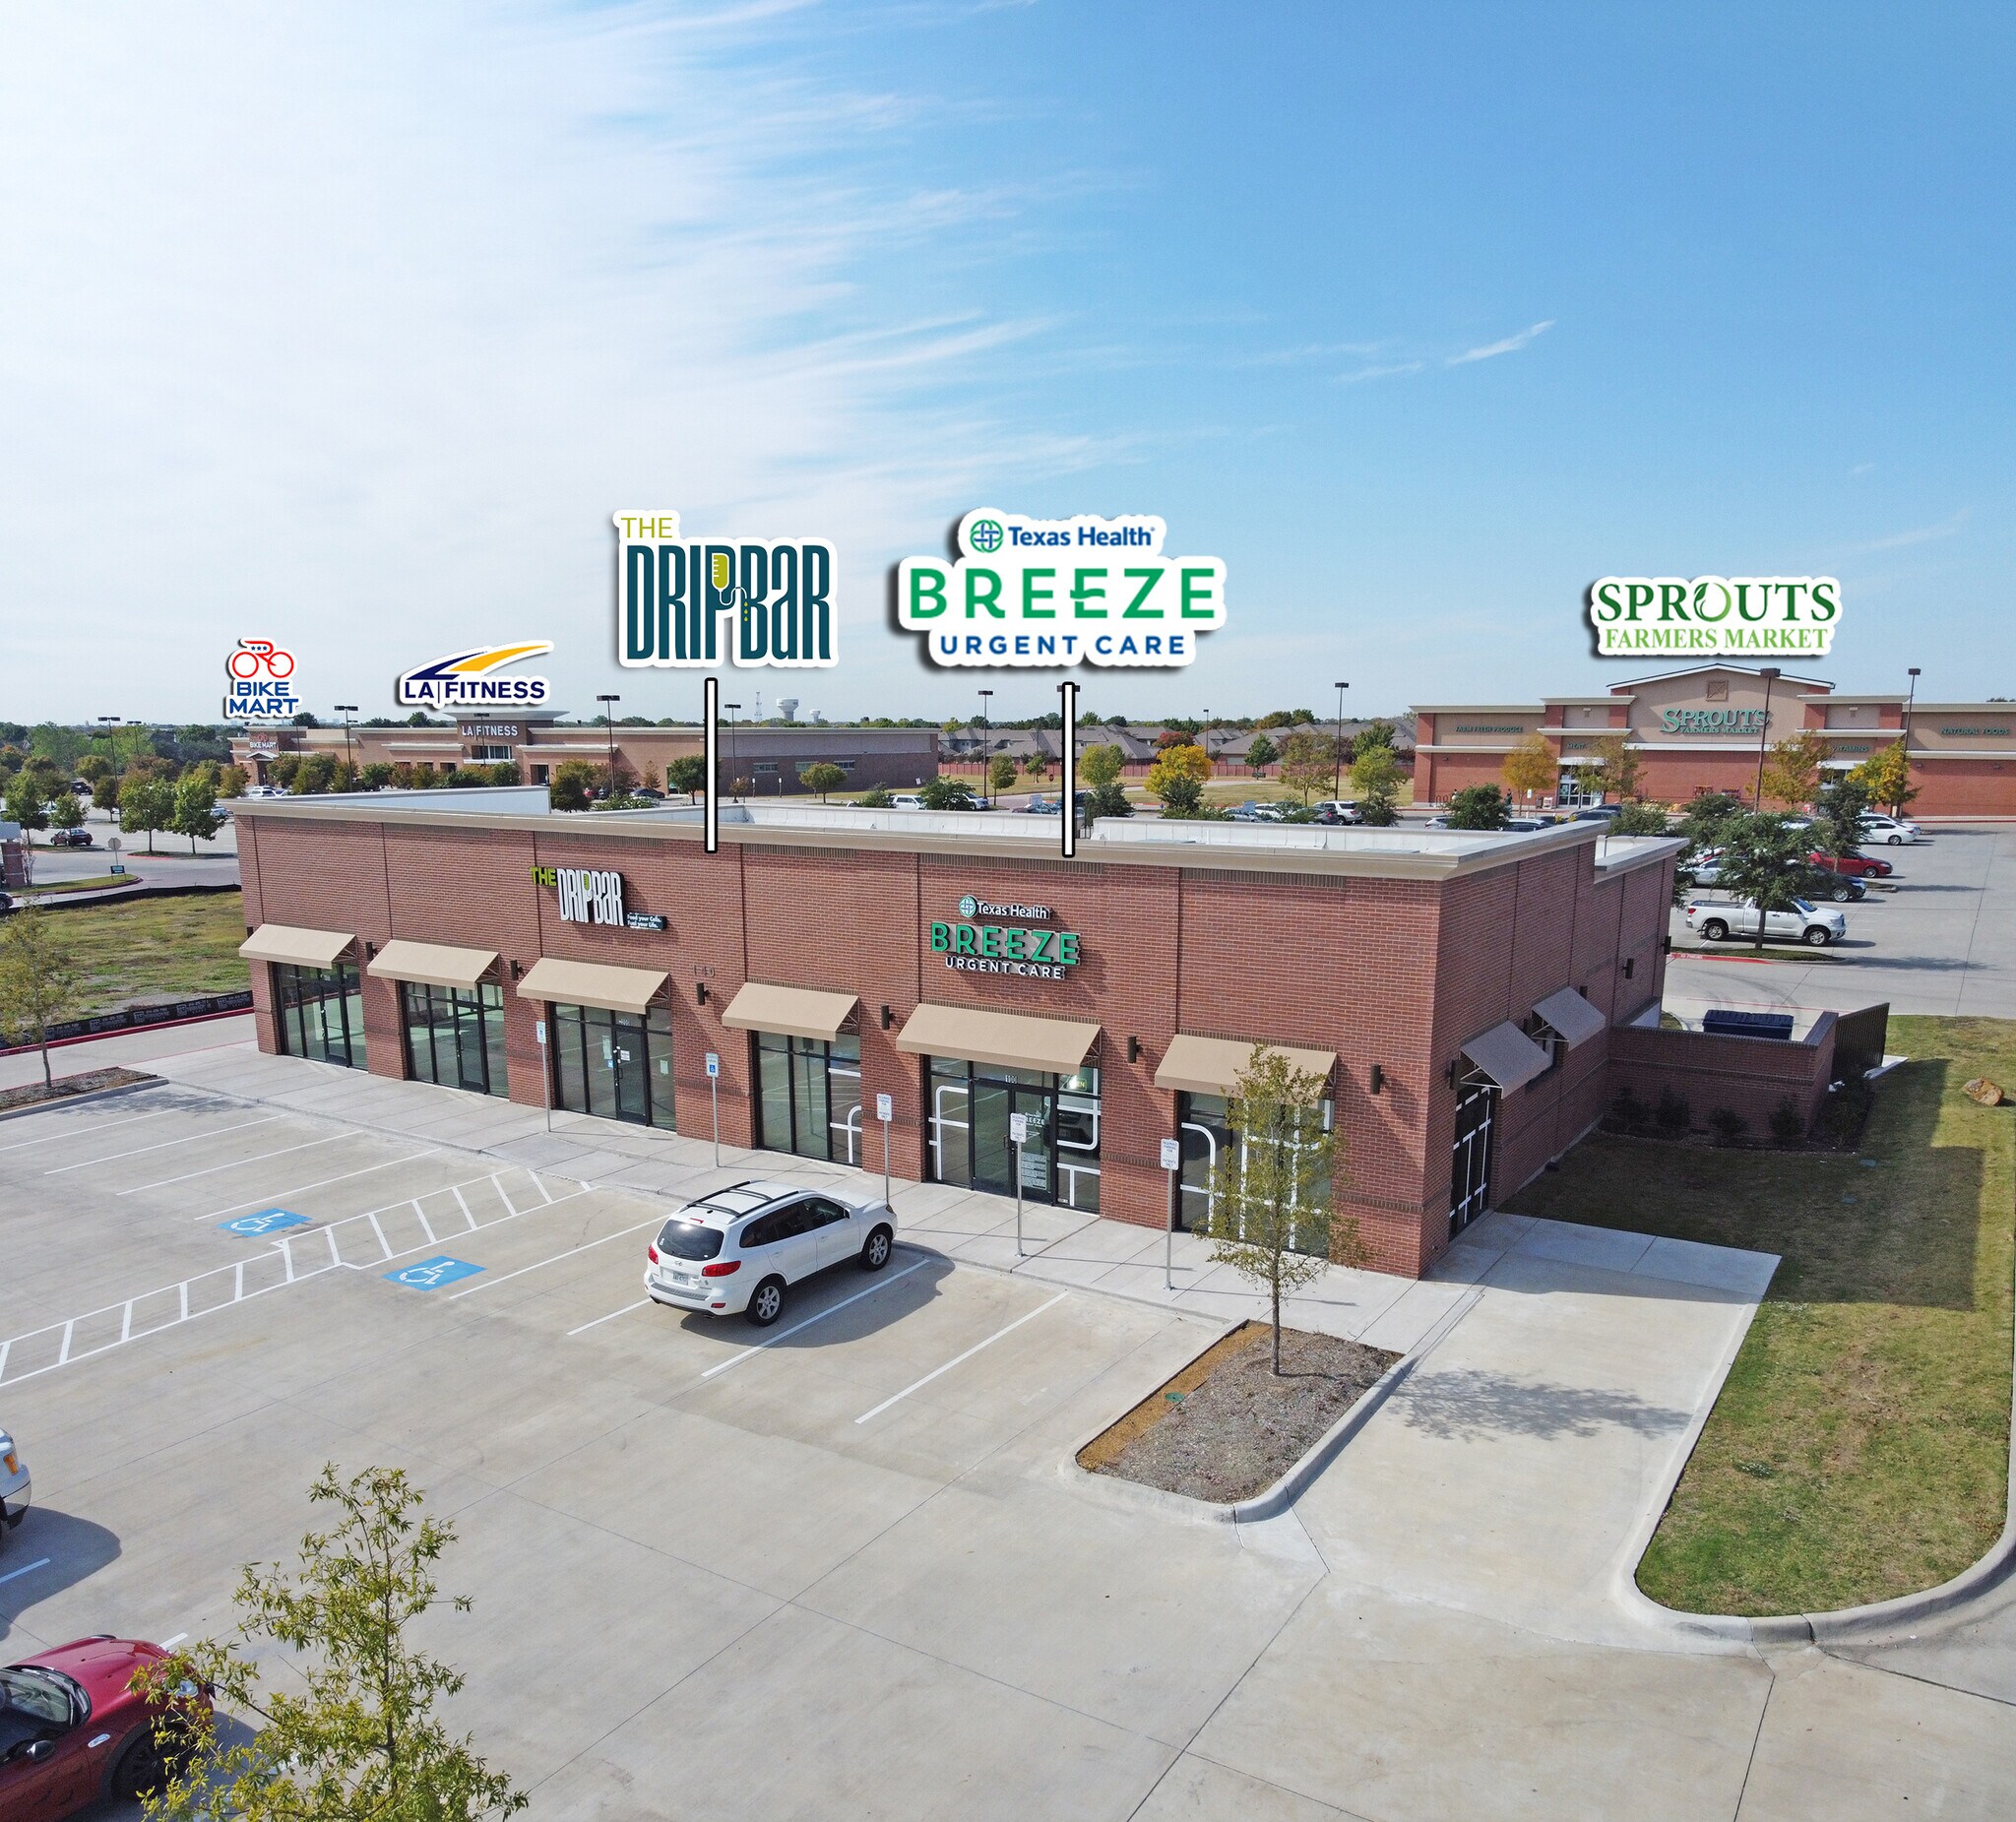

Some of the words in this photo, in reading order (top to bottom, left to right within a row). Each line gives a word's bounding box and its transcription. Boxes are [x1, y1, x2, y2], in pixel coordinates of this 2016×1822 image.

[1660, 708, 1770, 733] SPROUTS
[530, 866, 557, 887] THE
[976, 902, 1008, 916] Texas
[1010, 904, 1049, 920] Health
[931, 921, 1080, 965] BREEZE
[945, 957, 1011, 974] URGENT
[1018, 963, 1065, 980] CARE
